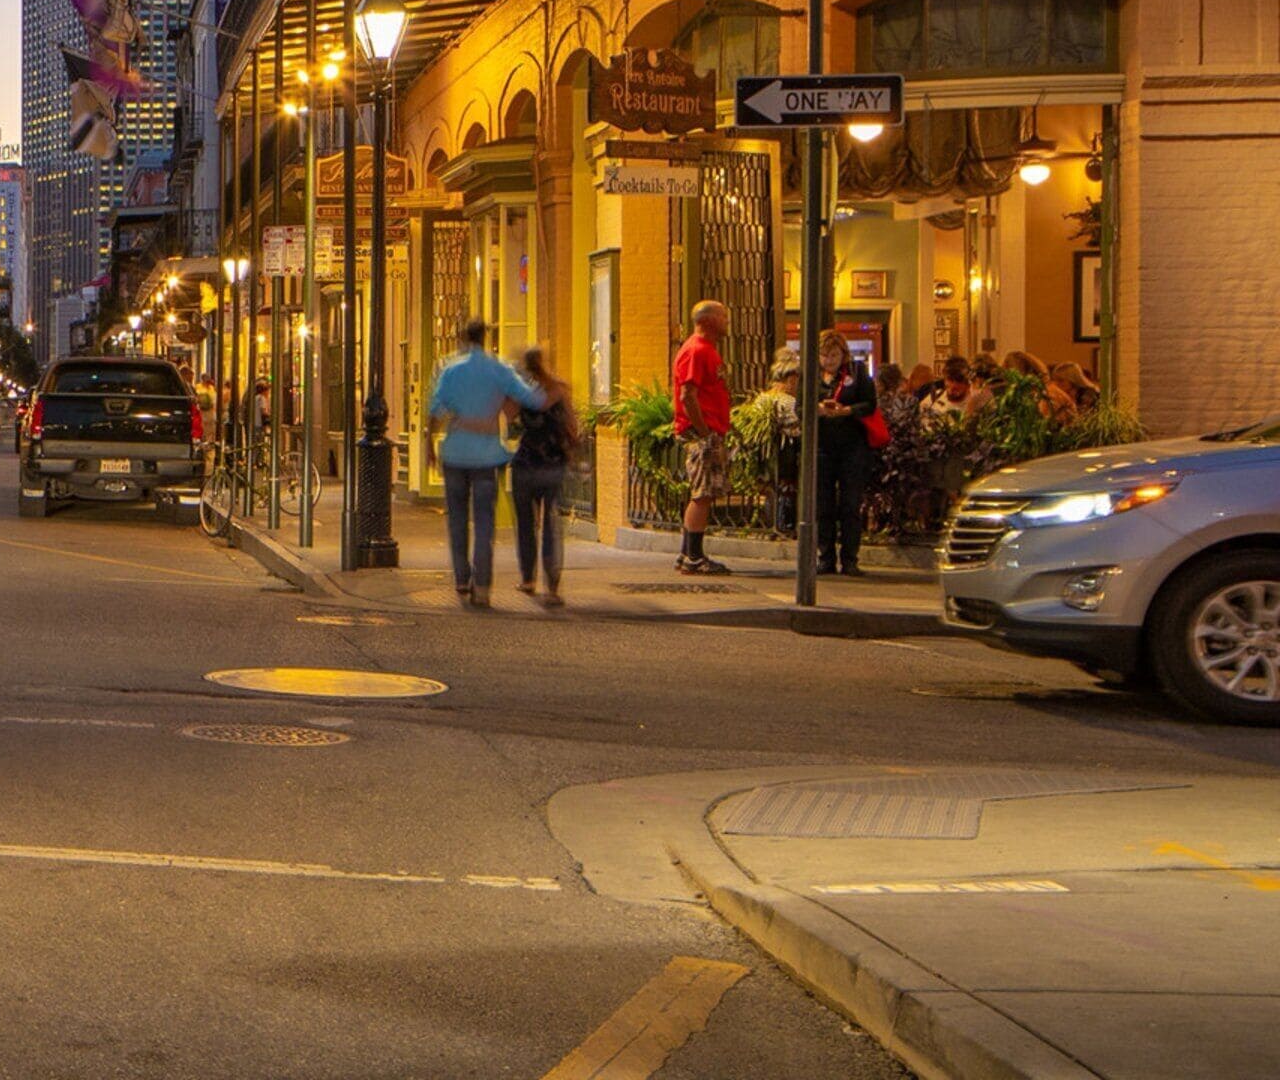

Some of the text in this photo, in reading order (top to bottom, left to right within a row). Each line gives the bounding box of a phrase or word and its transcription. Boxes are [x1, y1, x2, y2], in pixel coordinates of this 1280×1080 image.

[610, 83, 701, 116] Restaurant
[785, 91, 828, 110] ONE
[606, 175, 665, 194] Cocktails
